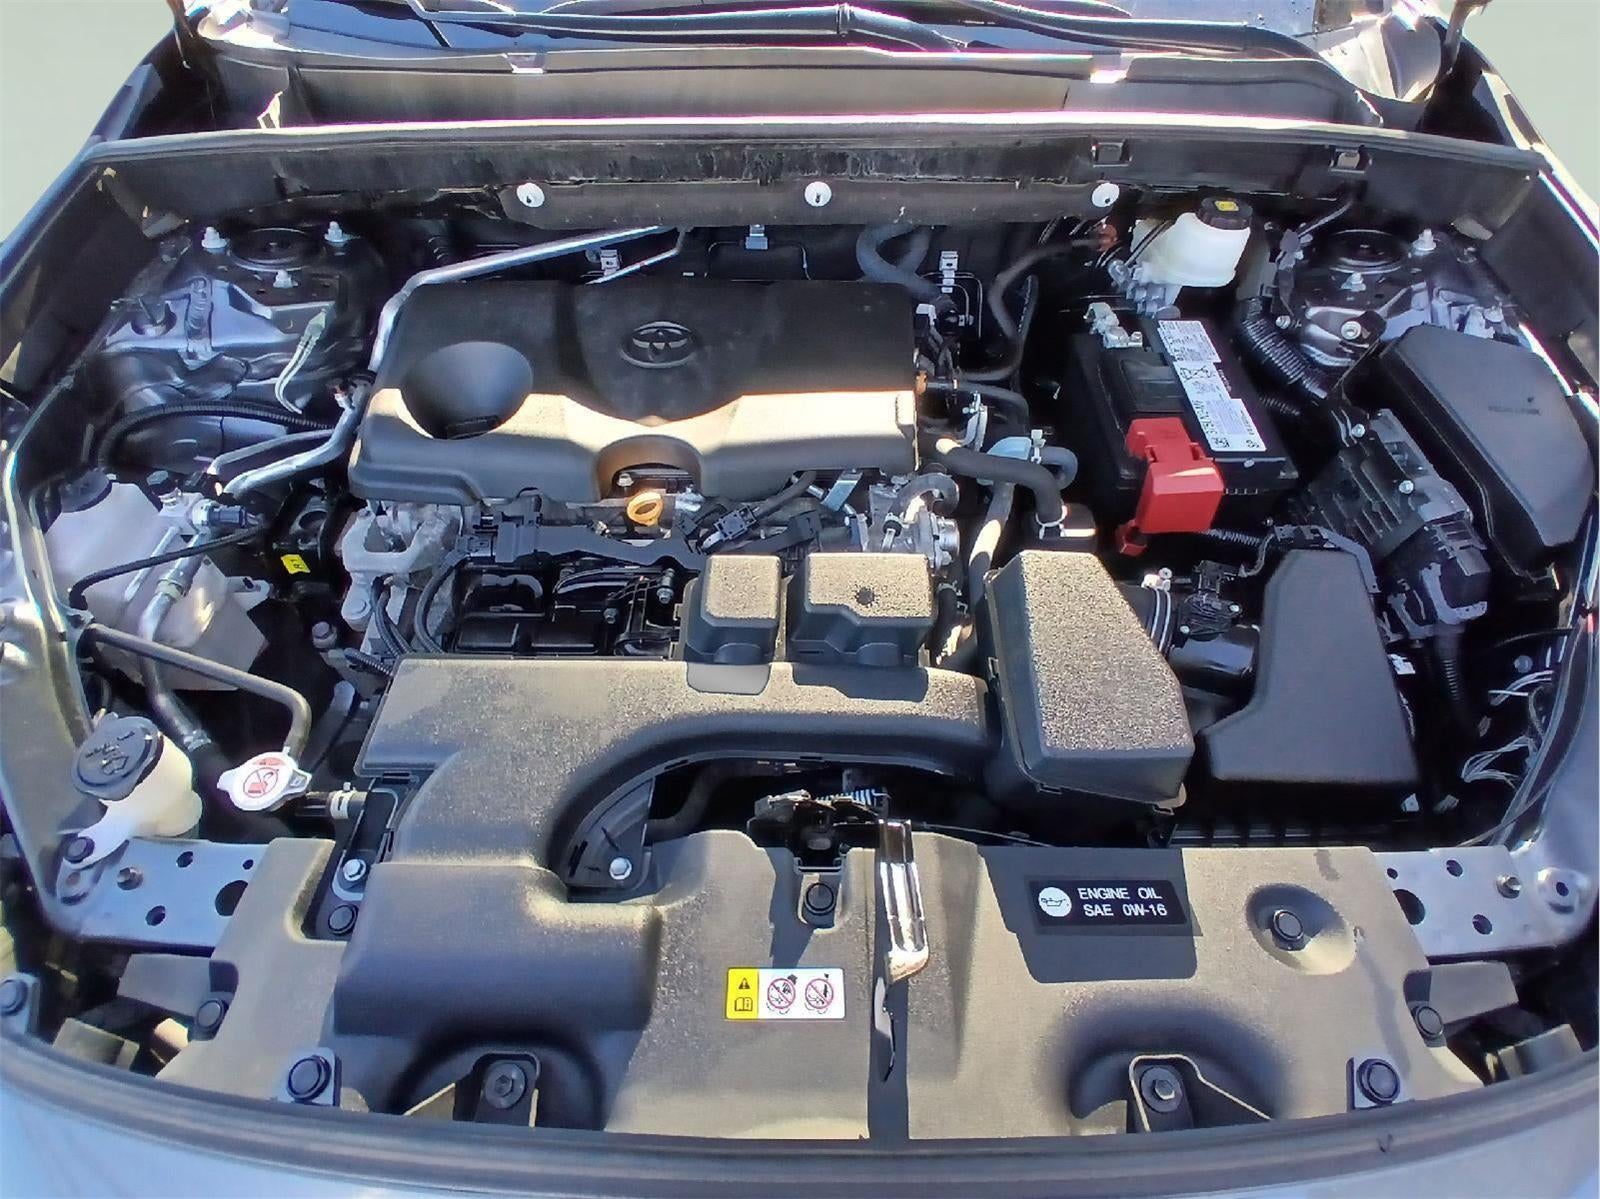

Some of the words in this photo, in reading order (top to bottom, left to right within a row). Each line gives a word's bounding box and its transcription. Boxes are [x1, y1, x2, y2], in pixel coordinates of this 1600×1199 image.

[1077, 887, 1130, 899] ENGINE
[1137, 887, 1162, 899] OIL
[1083, 904, 1114, 916] SAE
[1122, 904, 1167, 916] 0W-16
